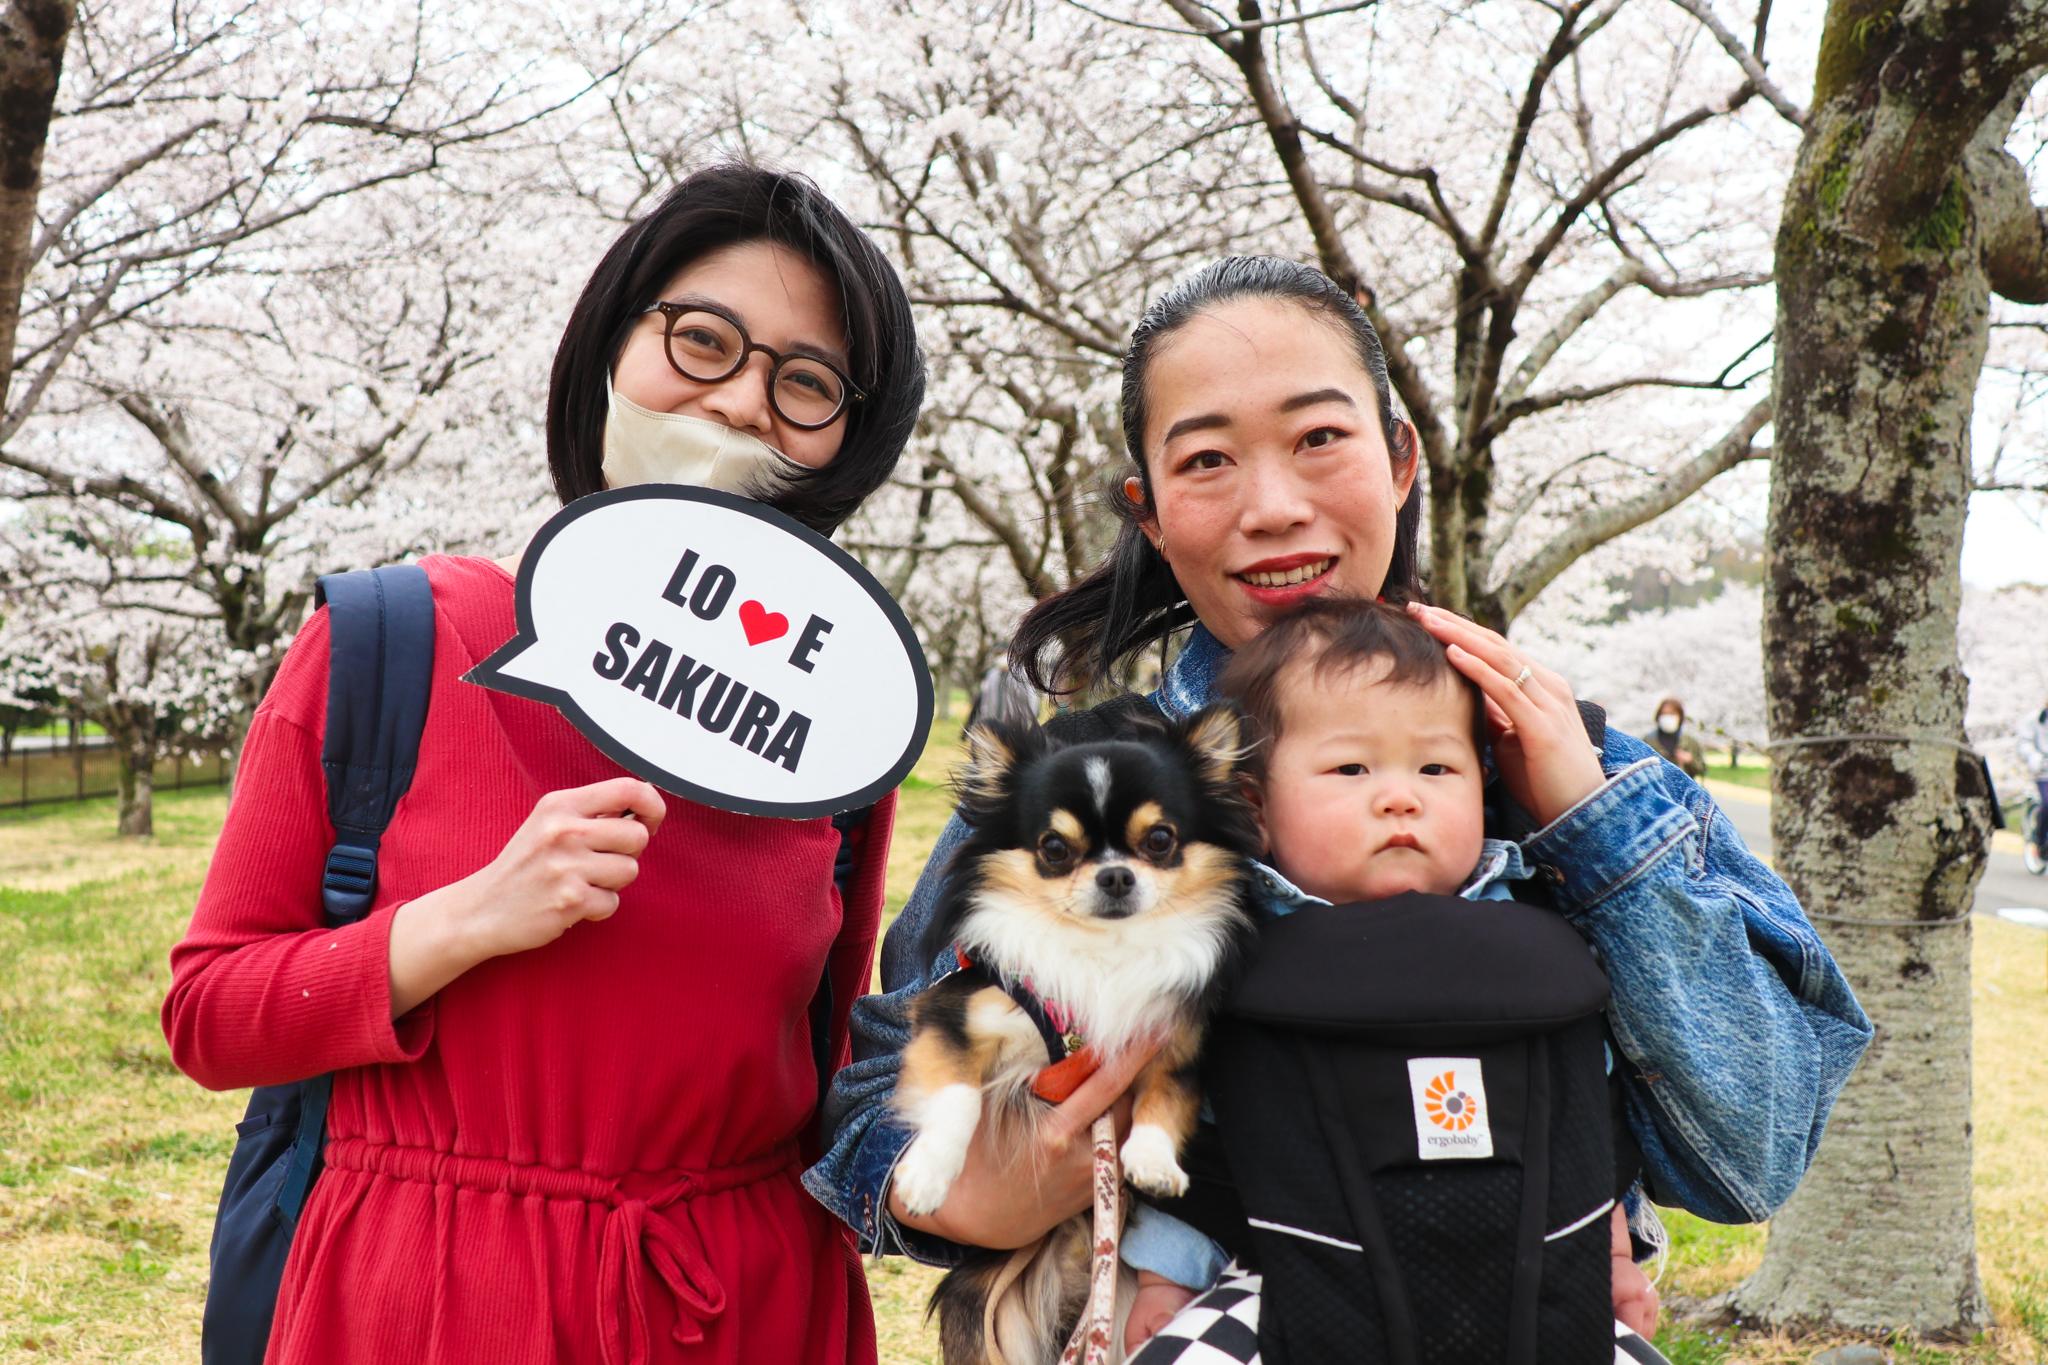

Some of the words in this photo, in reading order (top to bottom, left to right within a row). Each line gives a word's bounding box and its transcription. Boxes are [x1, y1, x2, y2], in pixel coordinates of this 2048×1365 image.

[661, 548, 834, 674] LOE
[592, 622, 812, 774] SAKURA
[1427, 1134, 1479, 1148] ergobaby
